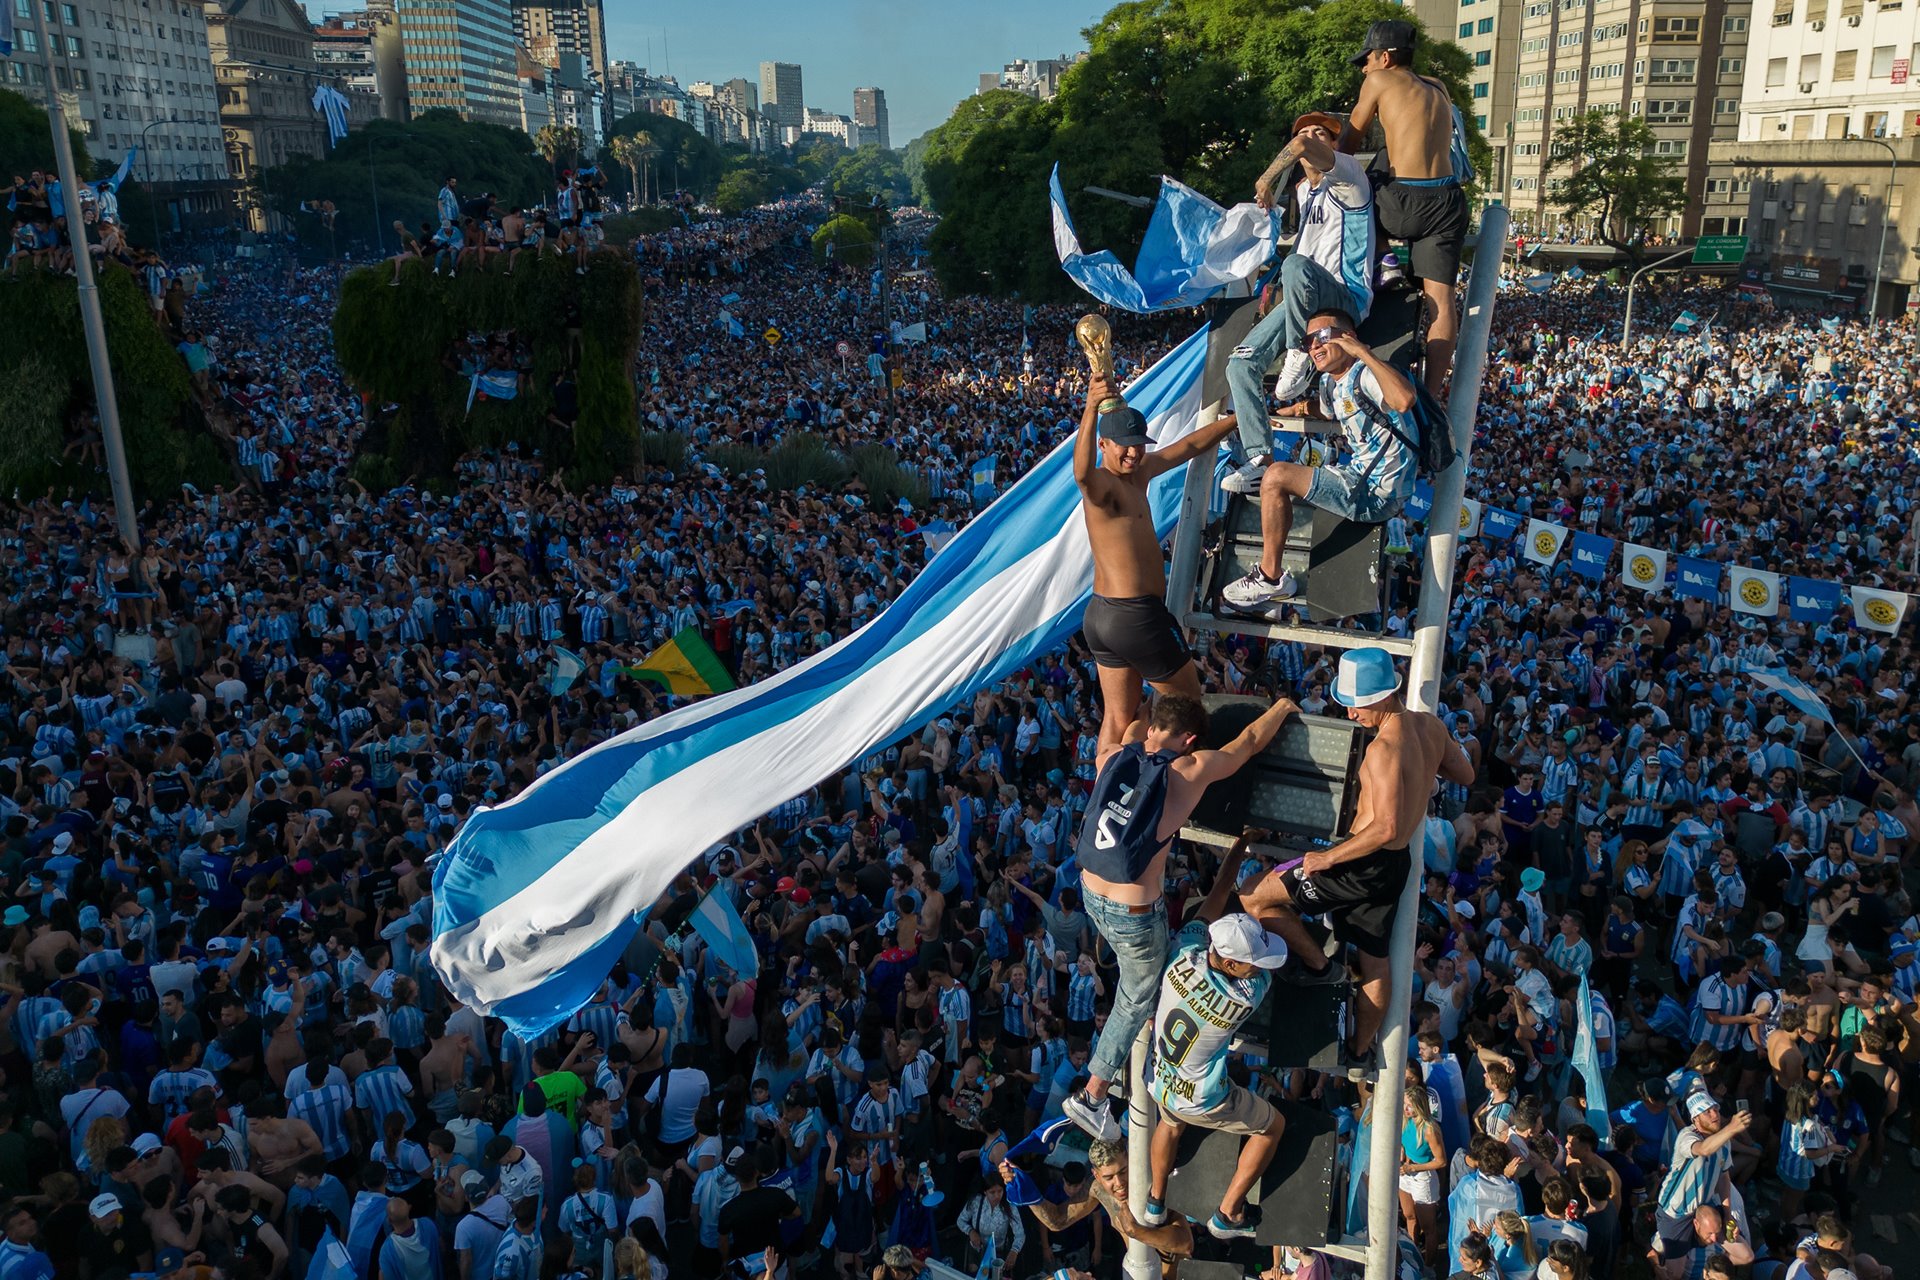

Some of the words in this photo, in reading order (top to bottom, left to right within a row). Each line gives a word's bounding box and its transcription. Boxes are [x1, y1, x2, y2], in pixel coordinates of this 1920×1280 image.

[1411, 495, 1424, 510] BA
[1491, 511, 1506, 526] BA
[1577, 548, 1594, 564] BA
[1684, 570, 1703, 586] BA
[1796, 595, 1821, 610] BA
[375, 750, 391, 764] 10
[203, 871, 219, 892] 10
[1167, 969, 1190, 999] BARRIO
[1173, 957, 1196, 984] LA
[1192, 978, 1254, 1022] PALITO
[131, 985, 150, 1003] 10
[1158, 1007, 1200, 1068] 9
